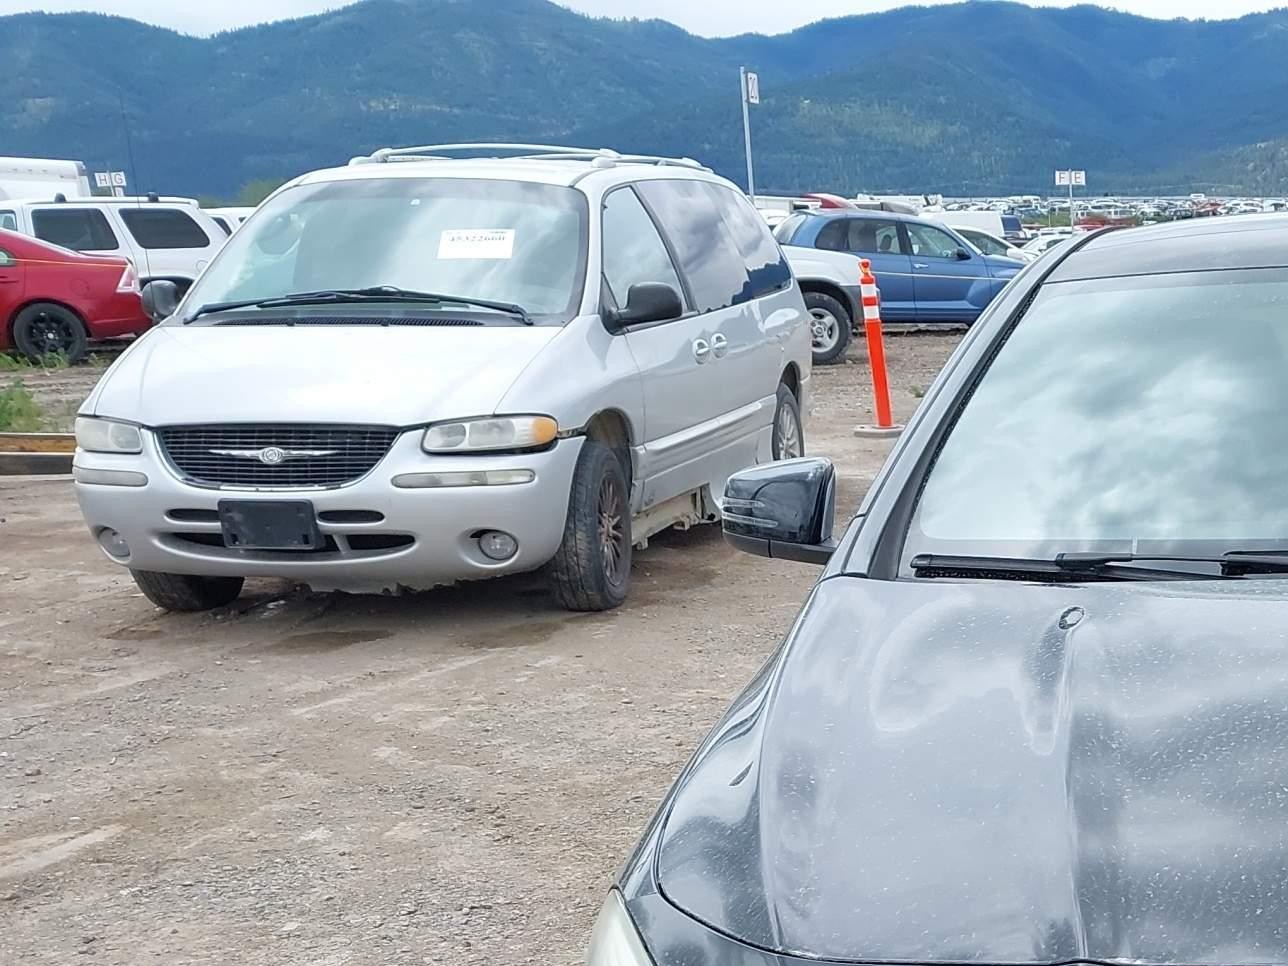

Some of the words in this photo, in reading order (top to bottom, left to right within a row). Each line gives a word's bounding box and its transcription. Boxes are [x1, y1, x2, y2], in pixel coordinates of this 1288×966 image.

[99, 174, 108, 185] H
[114, 173, 124, 184] G
[1058, 172, 1066, 183] F
[1074, 172, 1081, 183] E
